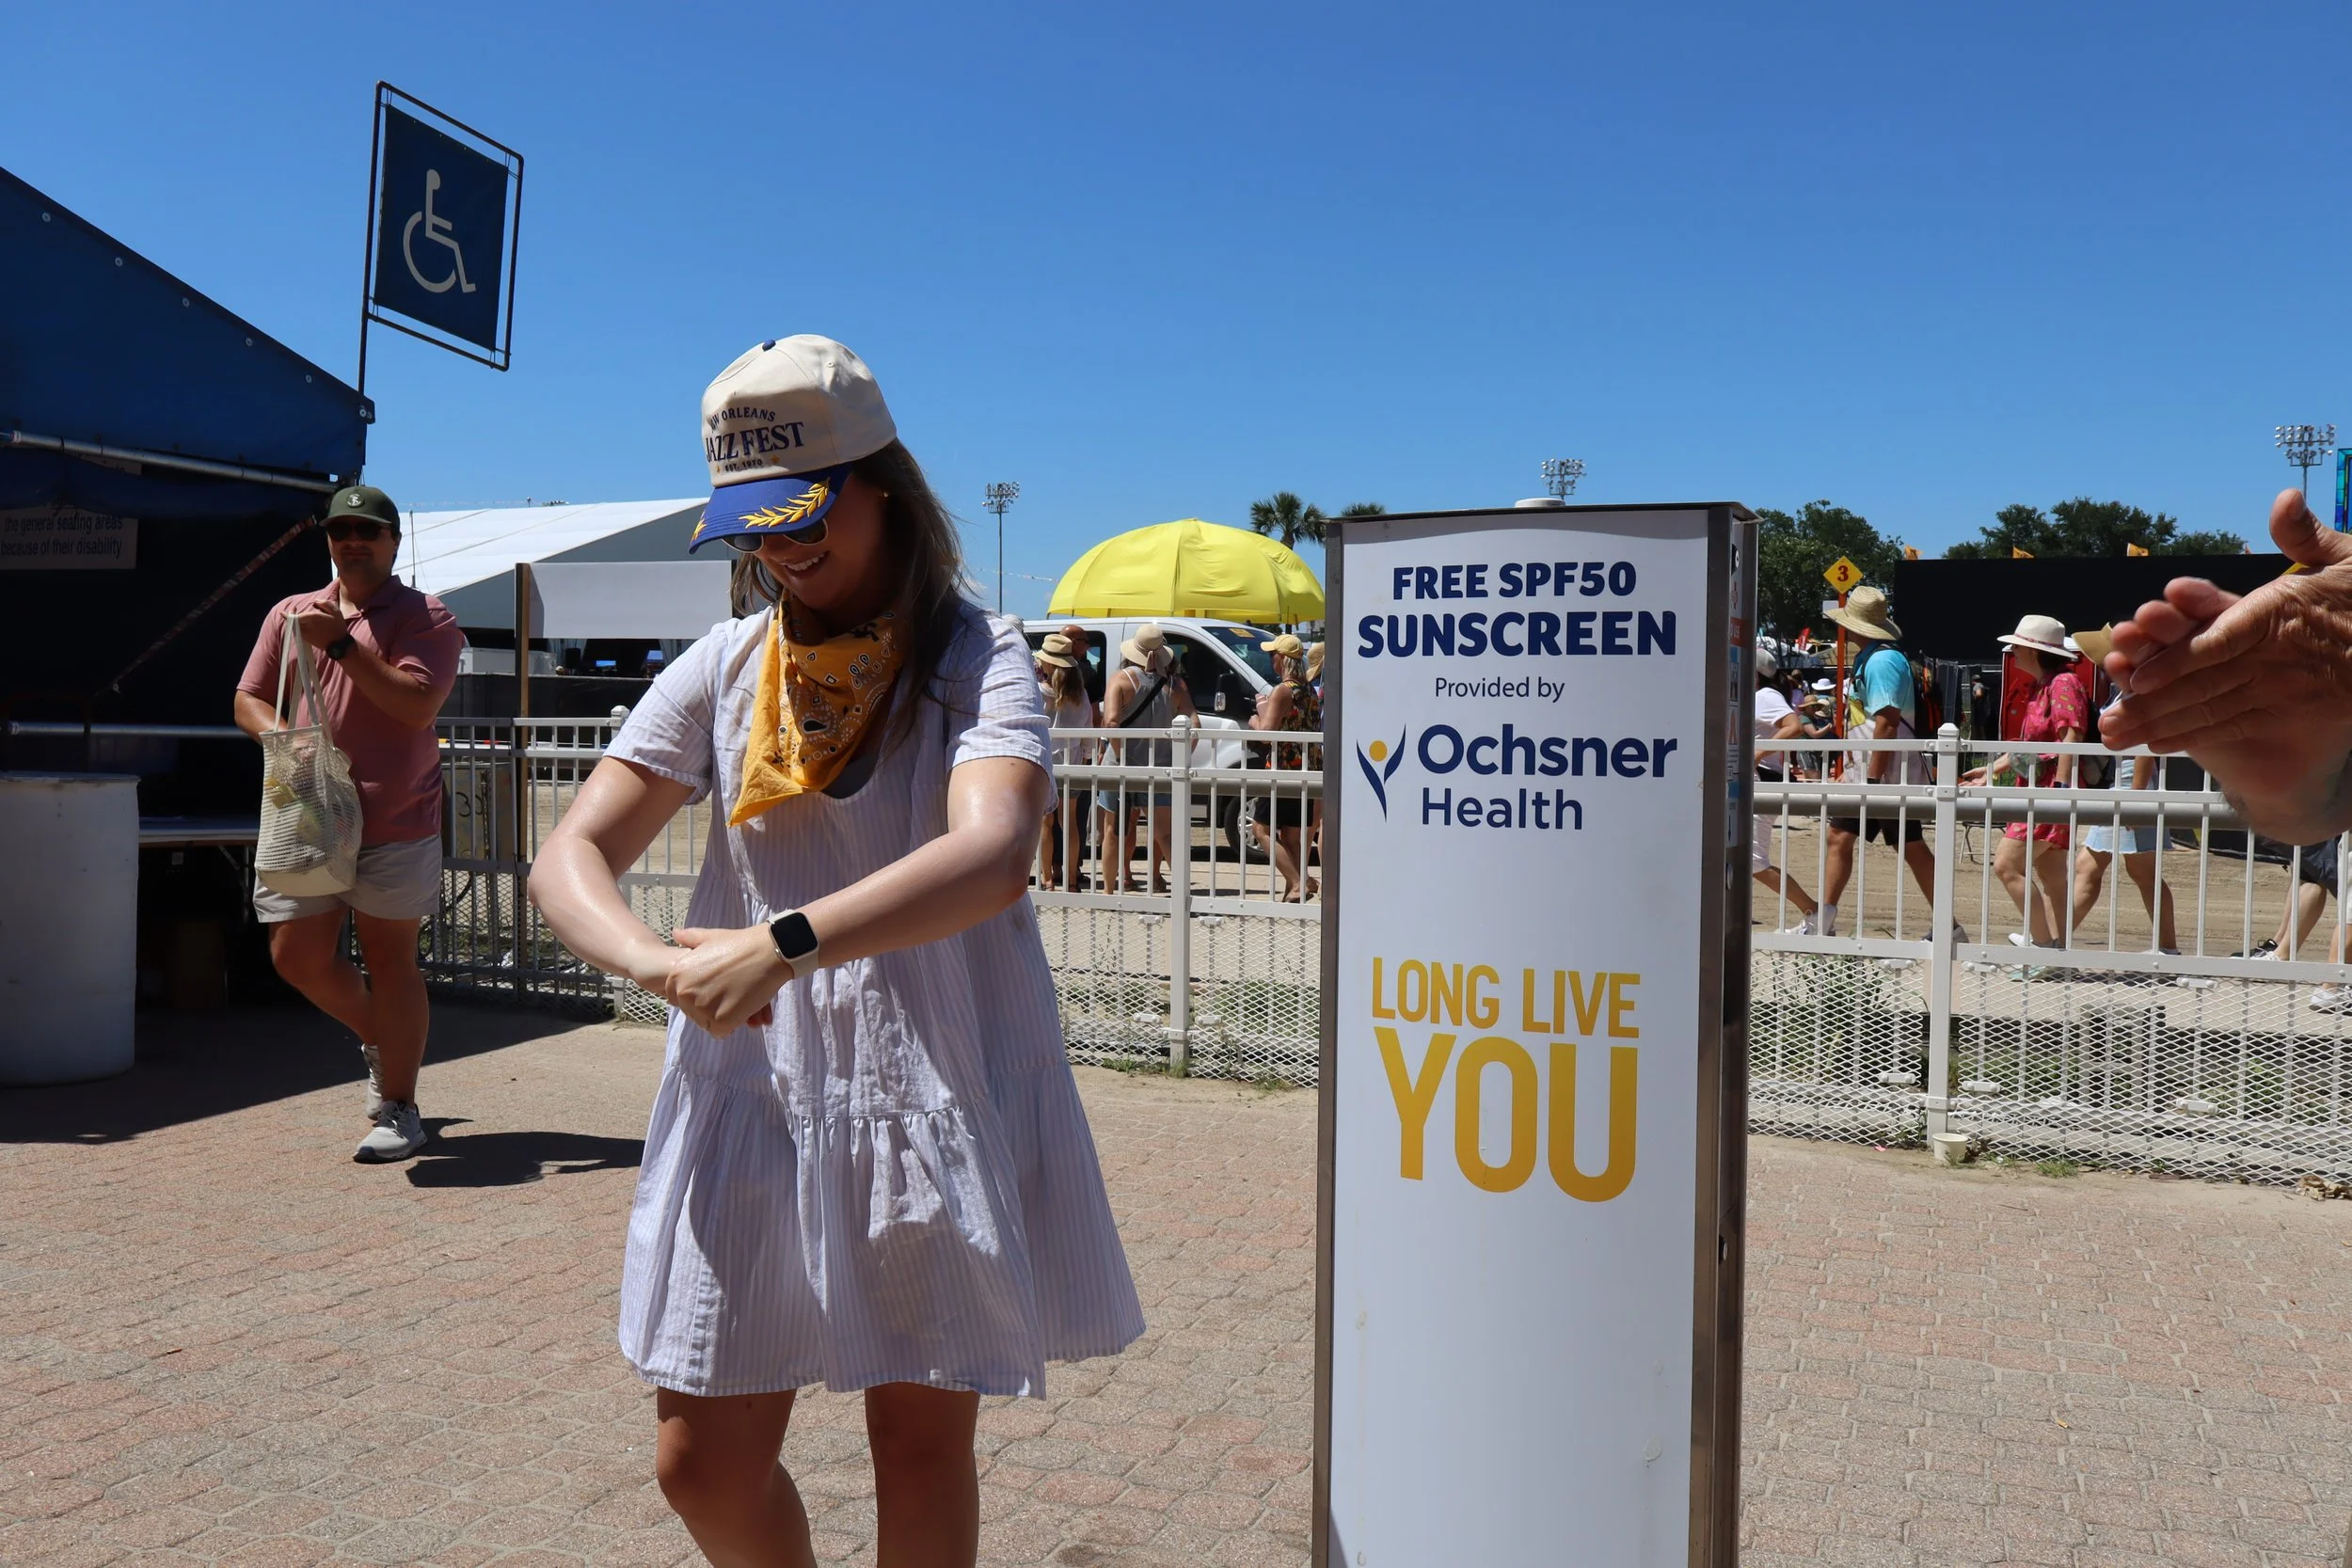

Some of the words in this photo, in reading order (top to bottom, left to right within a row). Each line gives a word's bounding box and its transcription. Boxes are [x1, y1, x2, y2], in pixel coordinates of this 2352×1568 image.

[722, 406, 776, 422] ORLEANS
[706, 433, 739, 463] JAZZ
[739, 421, 804, 455] FEST
[742, 459, 763, 468] 1970
[5, 516, 19, 532] the
[20, 516, 55, 536] general
[56, 514, 92, 534] seating
[95, 515, 123, 530] areas
[1, 540, 39, 556] because
[40, 538, 51, 555] of
[52, 537, 74, 555] their
[76, 536, 122, 560] disability
[1393, 563, 1489, 600] FREE
[1498, 561, 1637, 598] SPF50
[1837, 565, 1849, 581] 3
[1358, 610, 1677, 658] SUNSCREEN
[1435, 676, 1530, 698] Provided
[1537, 677, 1565, 703] by
[1418, 723, 1677, 778] Ochsner
[1422, 787, 1582, 831] Health
[1372, 957, 1501, 1029] LONG
[1522, 968, 1641, 1038] LIVE
[1374, 1025, 1638, 1202] YOU
